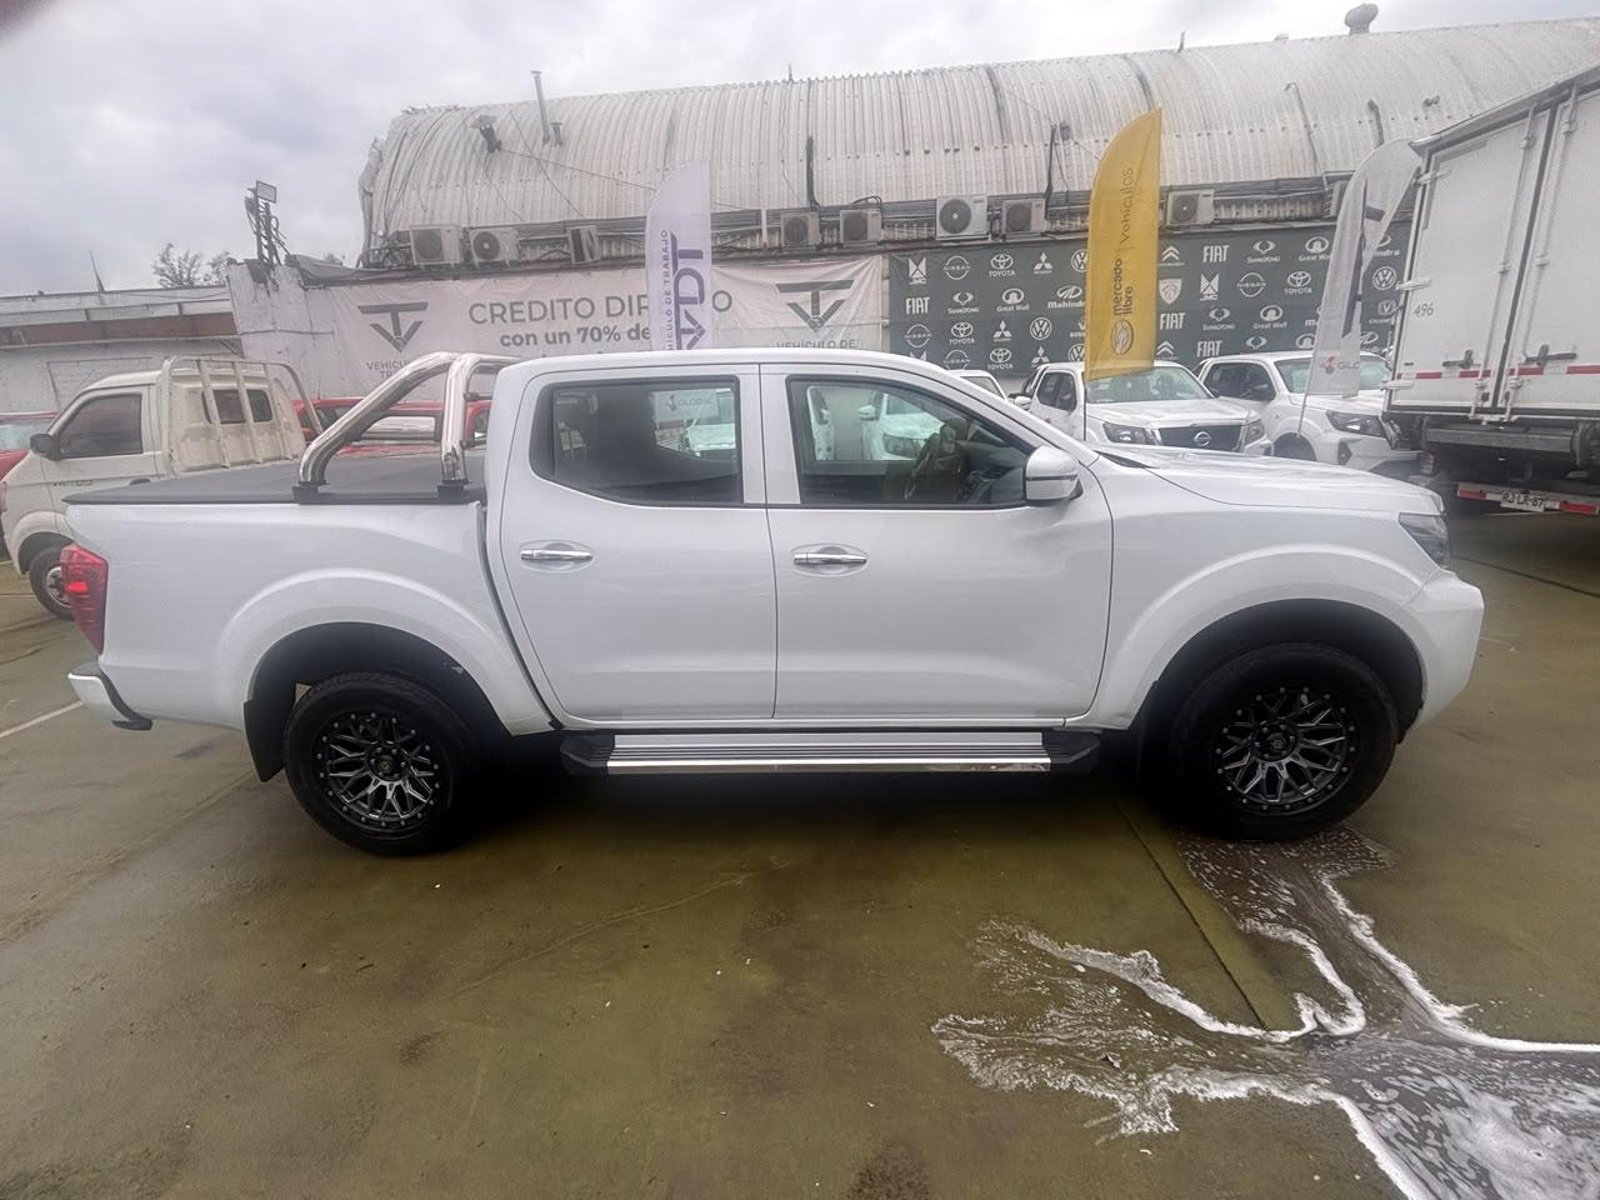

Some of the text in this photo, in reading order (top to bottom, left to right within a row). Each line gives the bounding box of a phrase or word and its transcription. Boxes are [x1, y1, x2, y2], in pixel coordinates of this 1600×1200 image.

[660, 230, 670, 284] TRABAJO
[1203, 245, 1230, 263] FIAT
[1112, 258, 1123, 316] mercado
[905, 297, 930, 315] FIAT
[1047, 300, 1085, 309] Mahindr
[1122, 286, 1134, 315] libre
[468, 297, 596, 325] CREDITO
[1160, 312, 1186, 330] FIAT
[500, 333, 538, 347] con
[545, 330, 571, 345] un
[577, 326, 621, 343] 70%
[1196, 340, 1223, 358] FIAT
